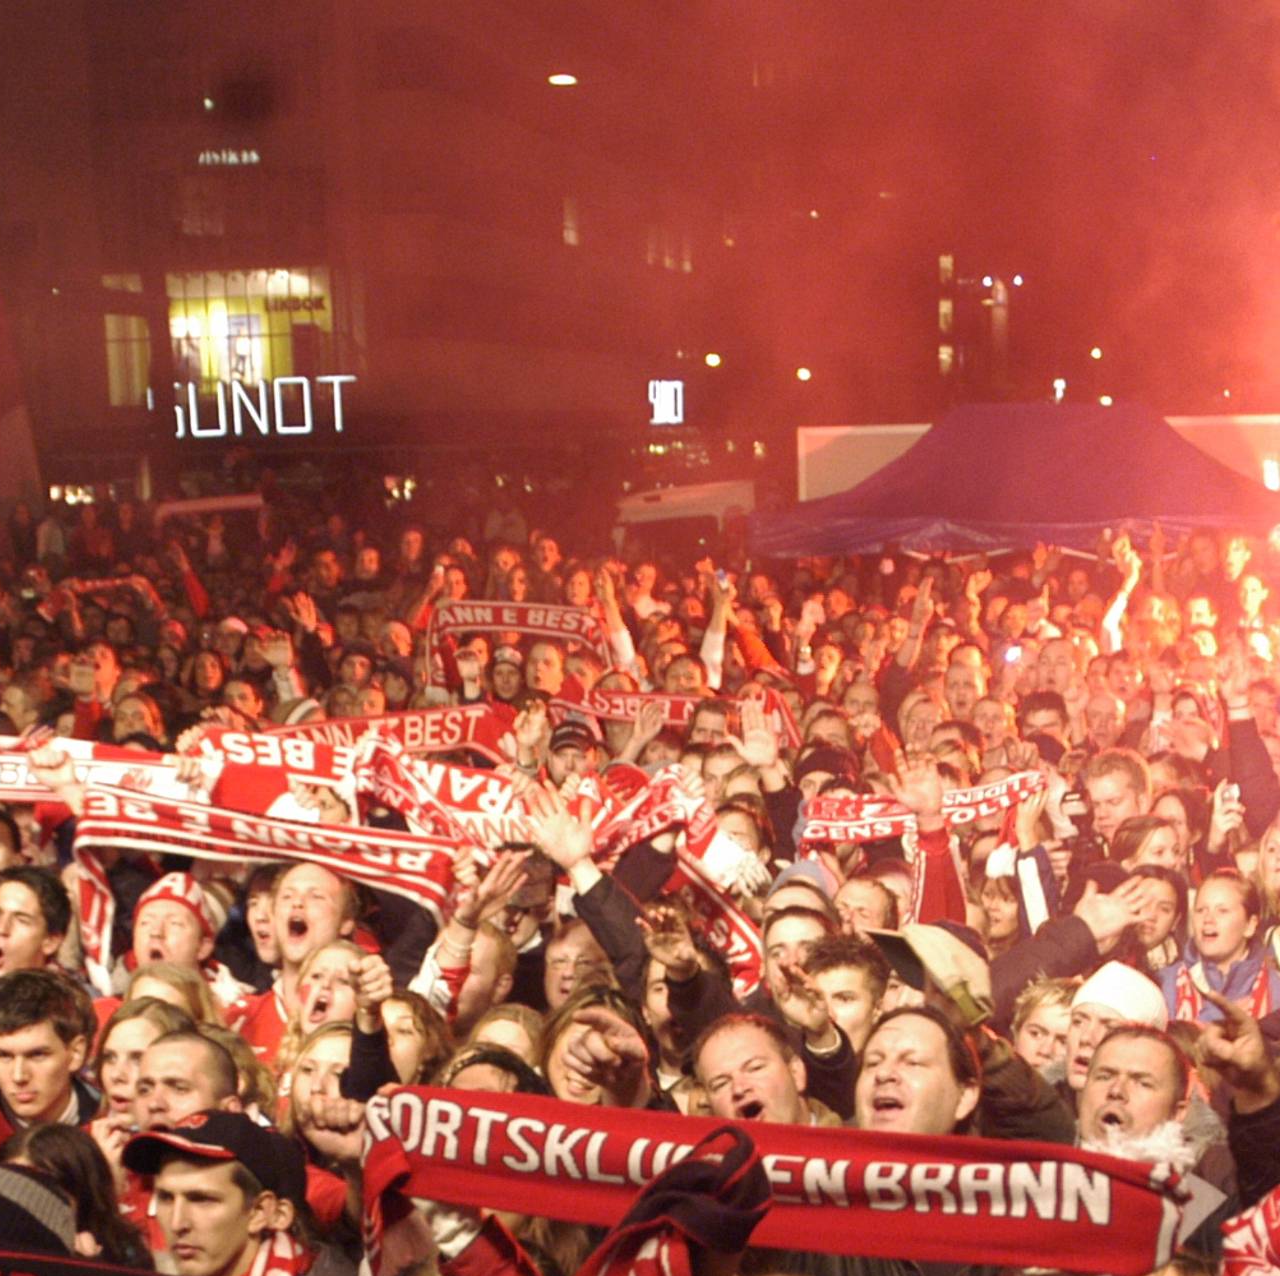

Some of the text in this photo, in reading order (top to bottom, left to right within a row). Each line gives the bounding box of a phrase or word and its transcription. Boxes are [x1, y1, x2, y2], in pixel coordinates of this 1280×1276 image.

[502, 608, 518, 623] E
[404, 710, 484, 748] BEST
[362, 1092, 1113, 1226] PORTSKLUEN BRANN
